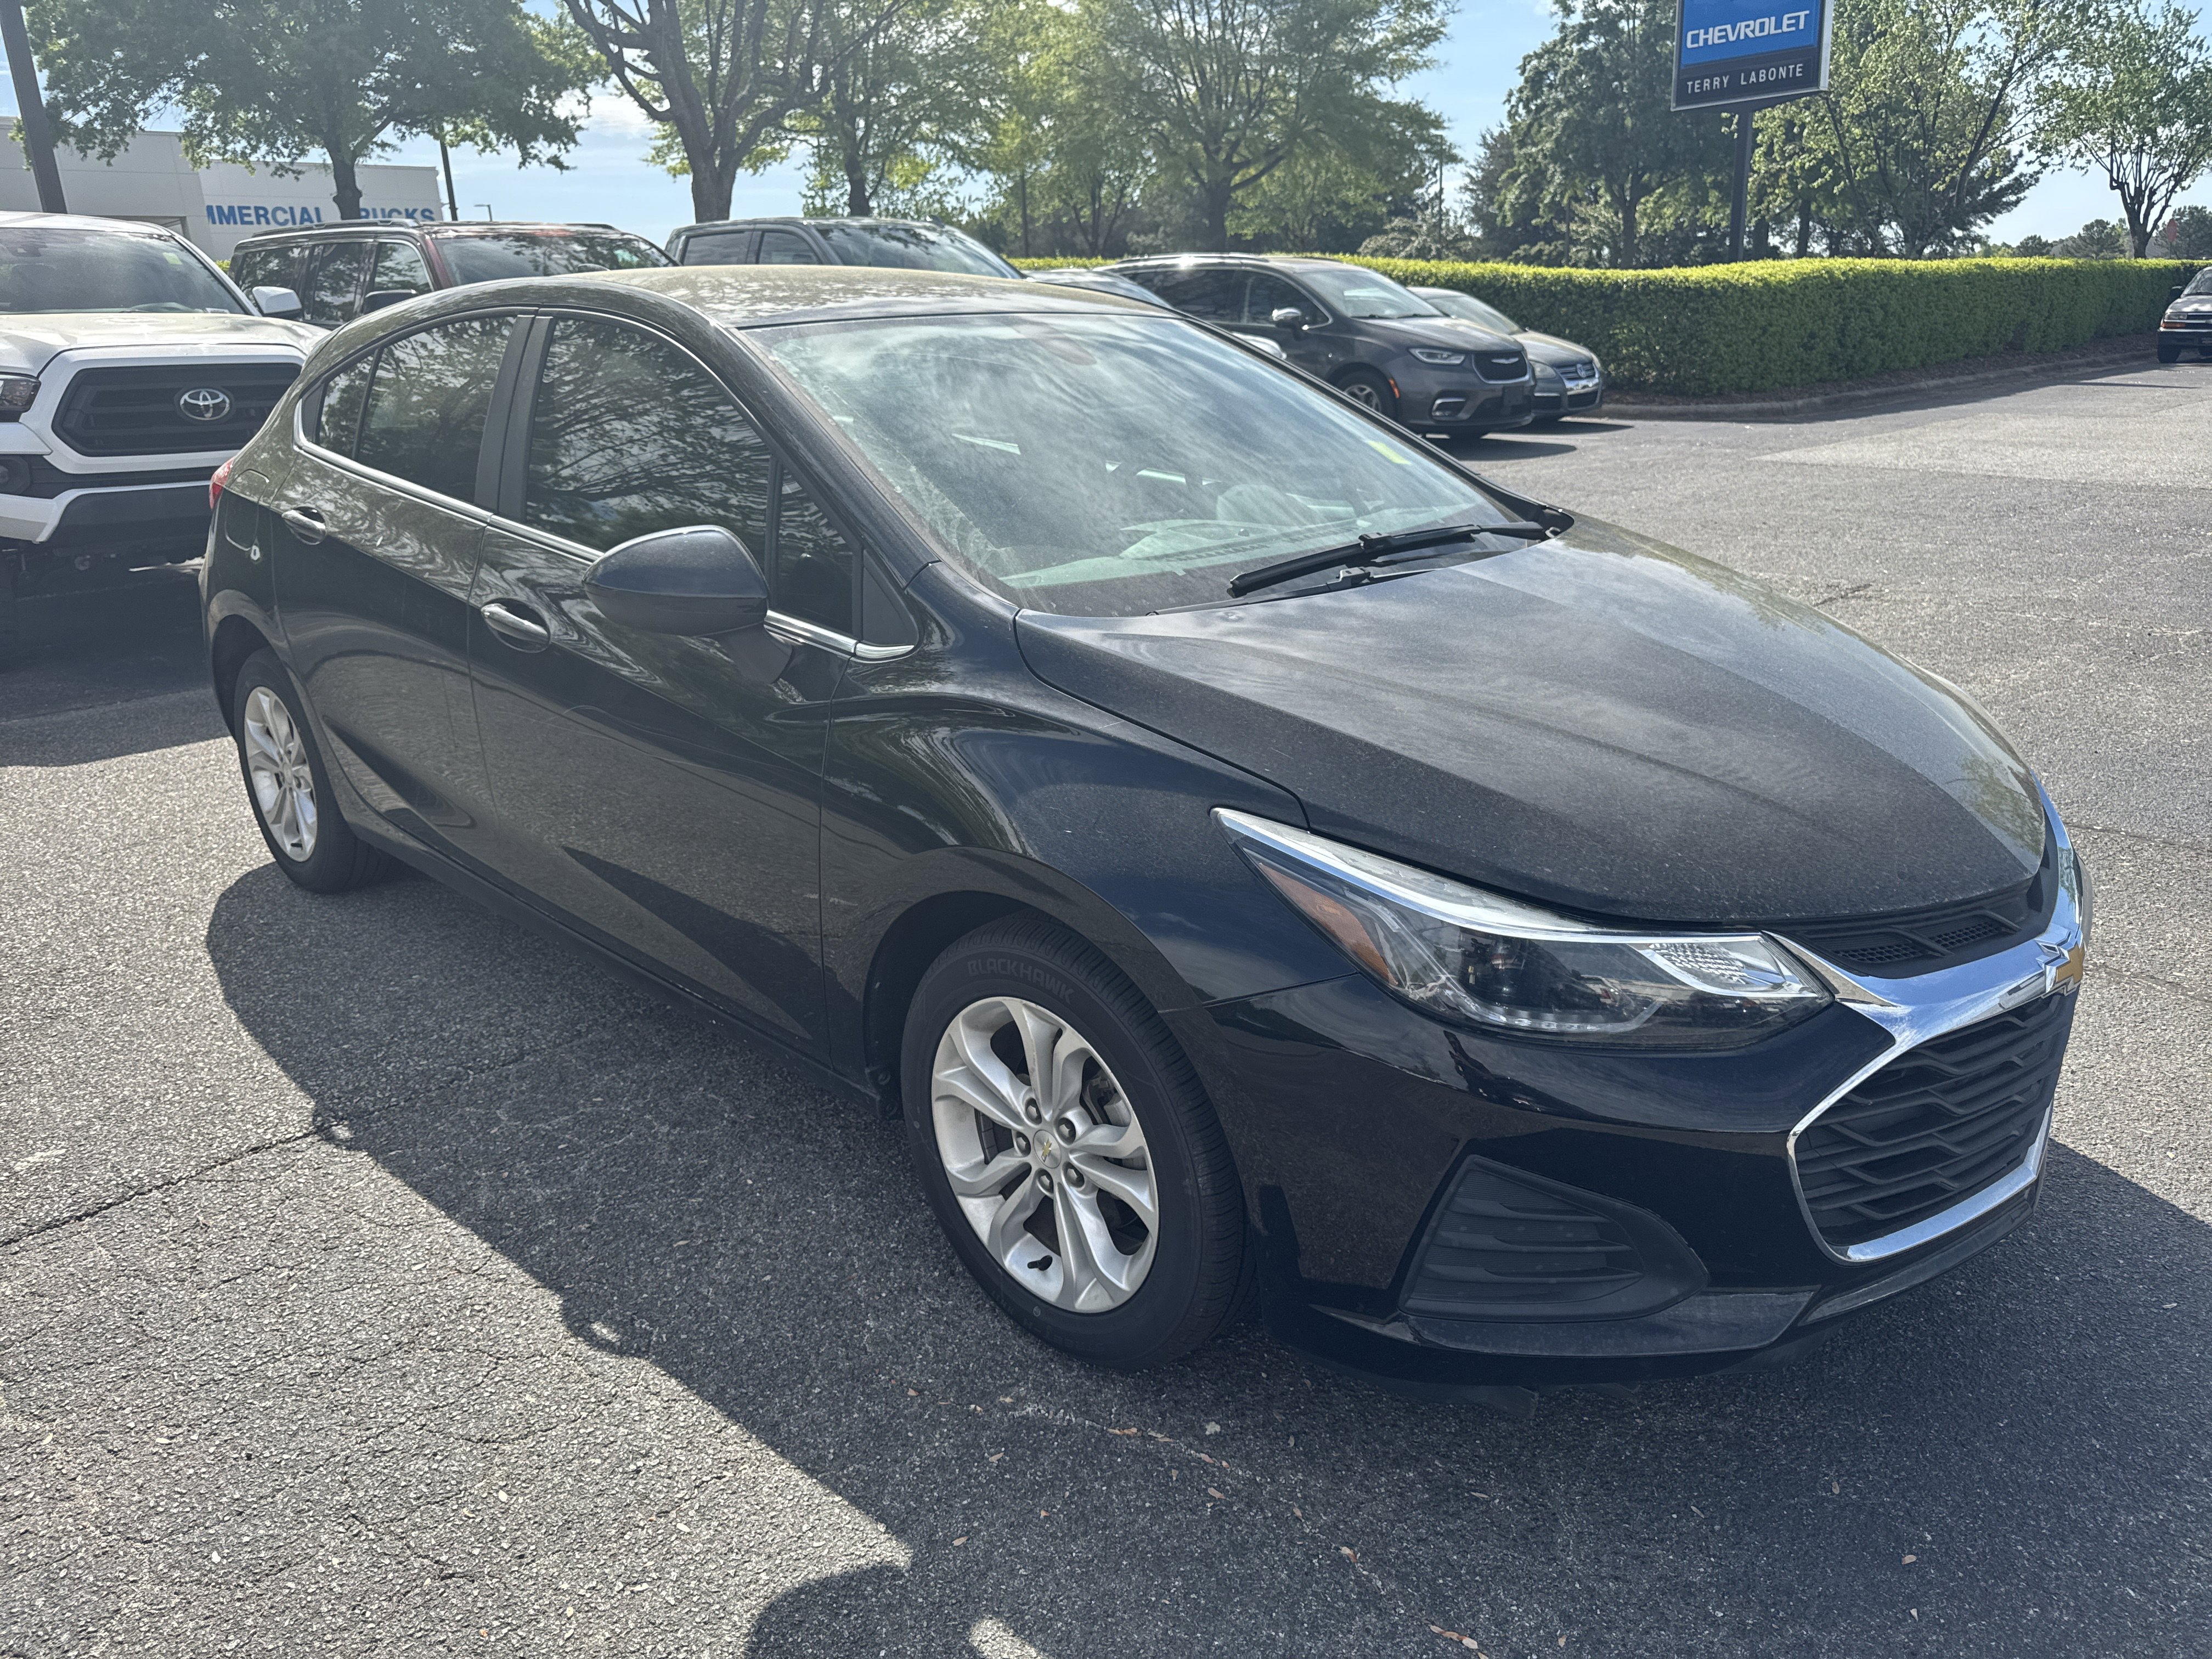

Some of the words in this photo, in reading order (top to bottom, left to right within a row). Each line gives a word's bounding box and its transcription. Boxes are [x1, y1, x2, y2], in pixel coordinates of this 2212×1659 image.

[1686, 10, 1810, 49] CHEVROLET
[1686, 75, 1729, 94] TERRY
[1741, 64, 1803, 85] LABONTE
[967, 958, 1075, 1003] BLACKHAWK
